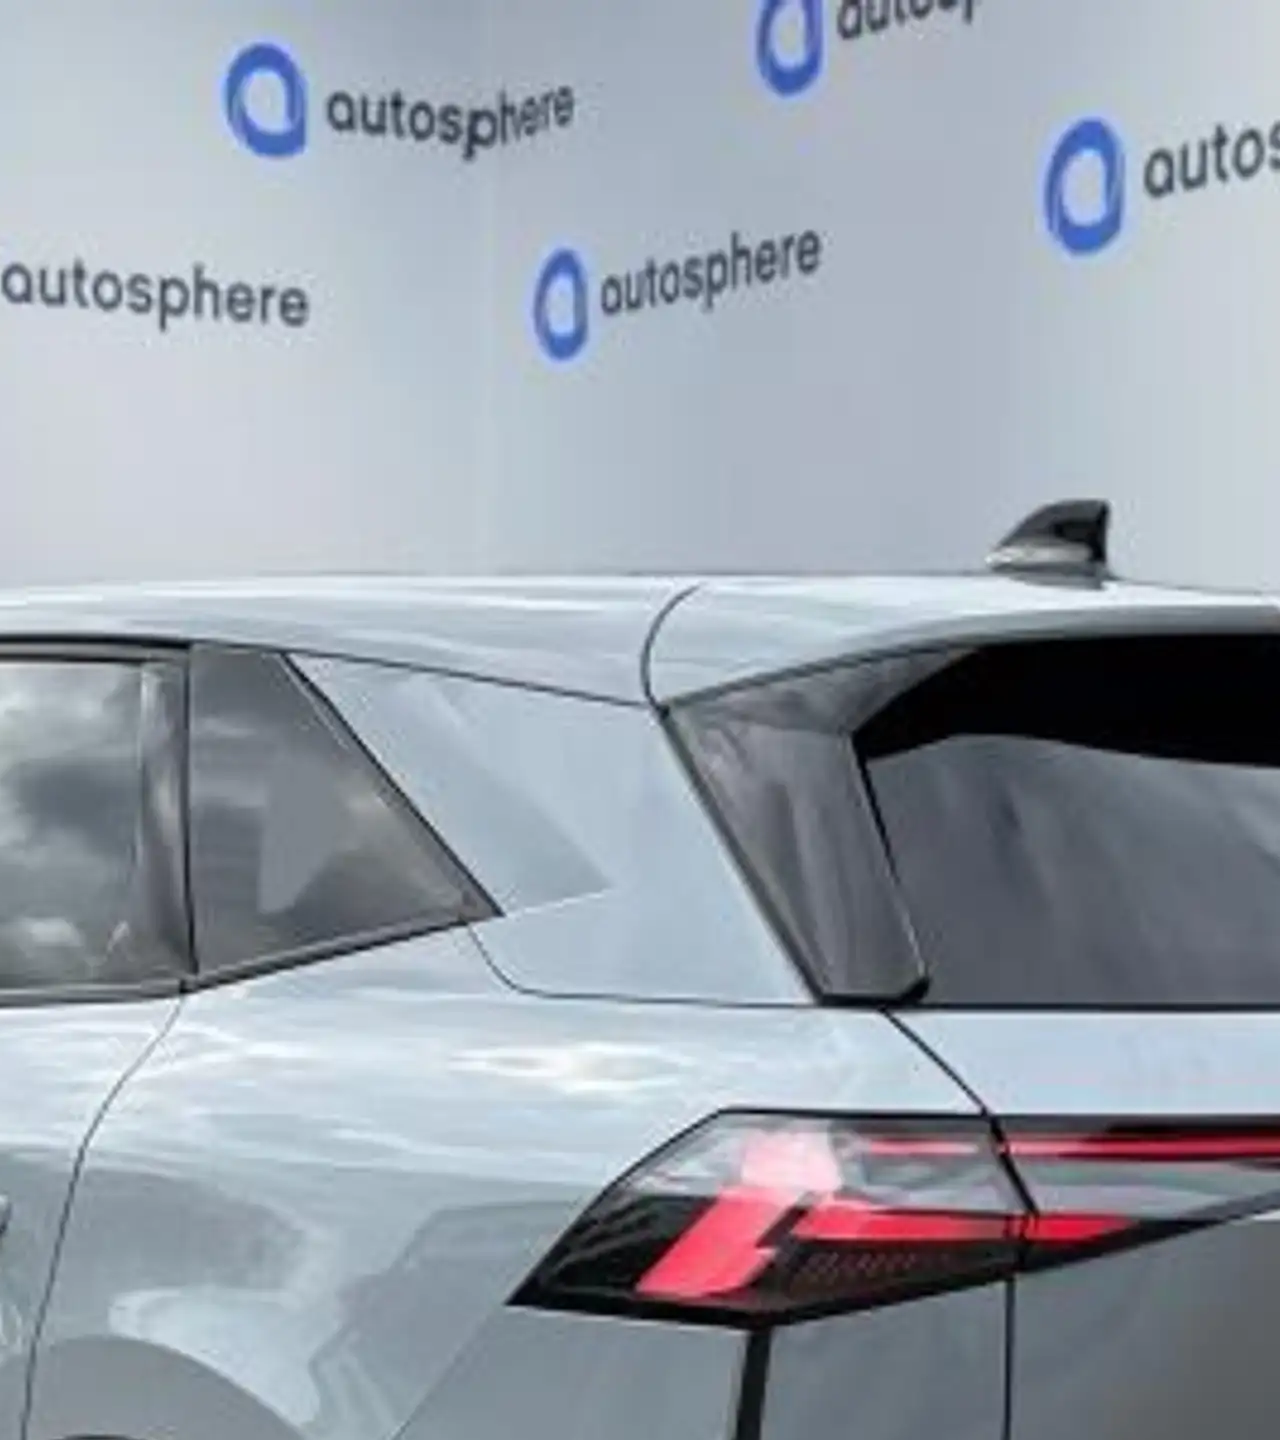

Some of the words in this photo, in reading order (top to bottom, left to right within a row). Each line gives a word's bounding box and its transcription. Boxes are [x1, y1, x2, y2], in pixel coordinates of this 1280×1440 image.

[325, 84, 575, 162] autosphere
[0, 258, 310, 333] autosphere
[600, 228, 824, 319] autosphere
